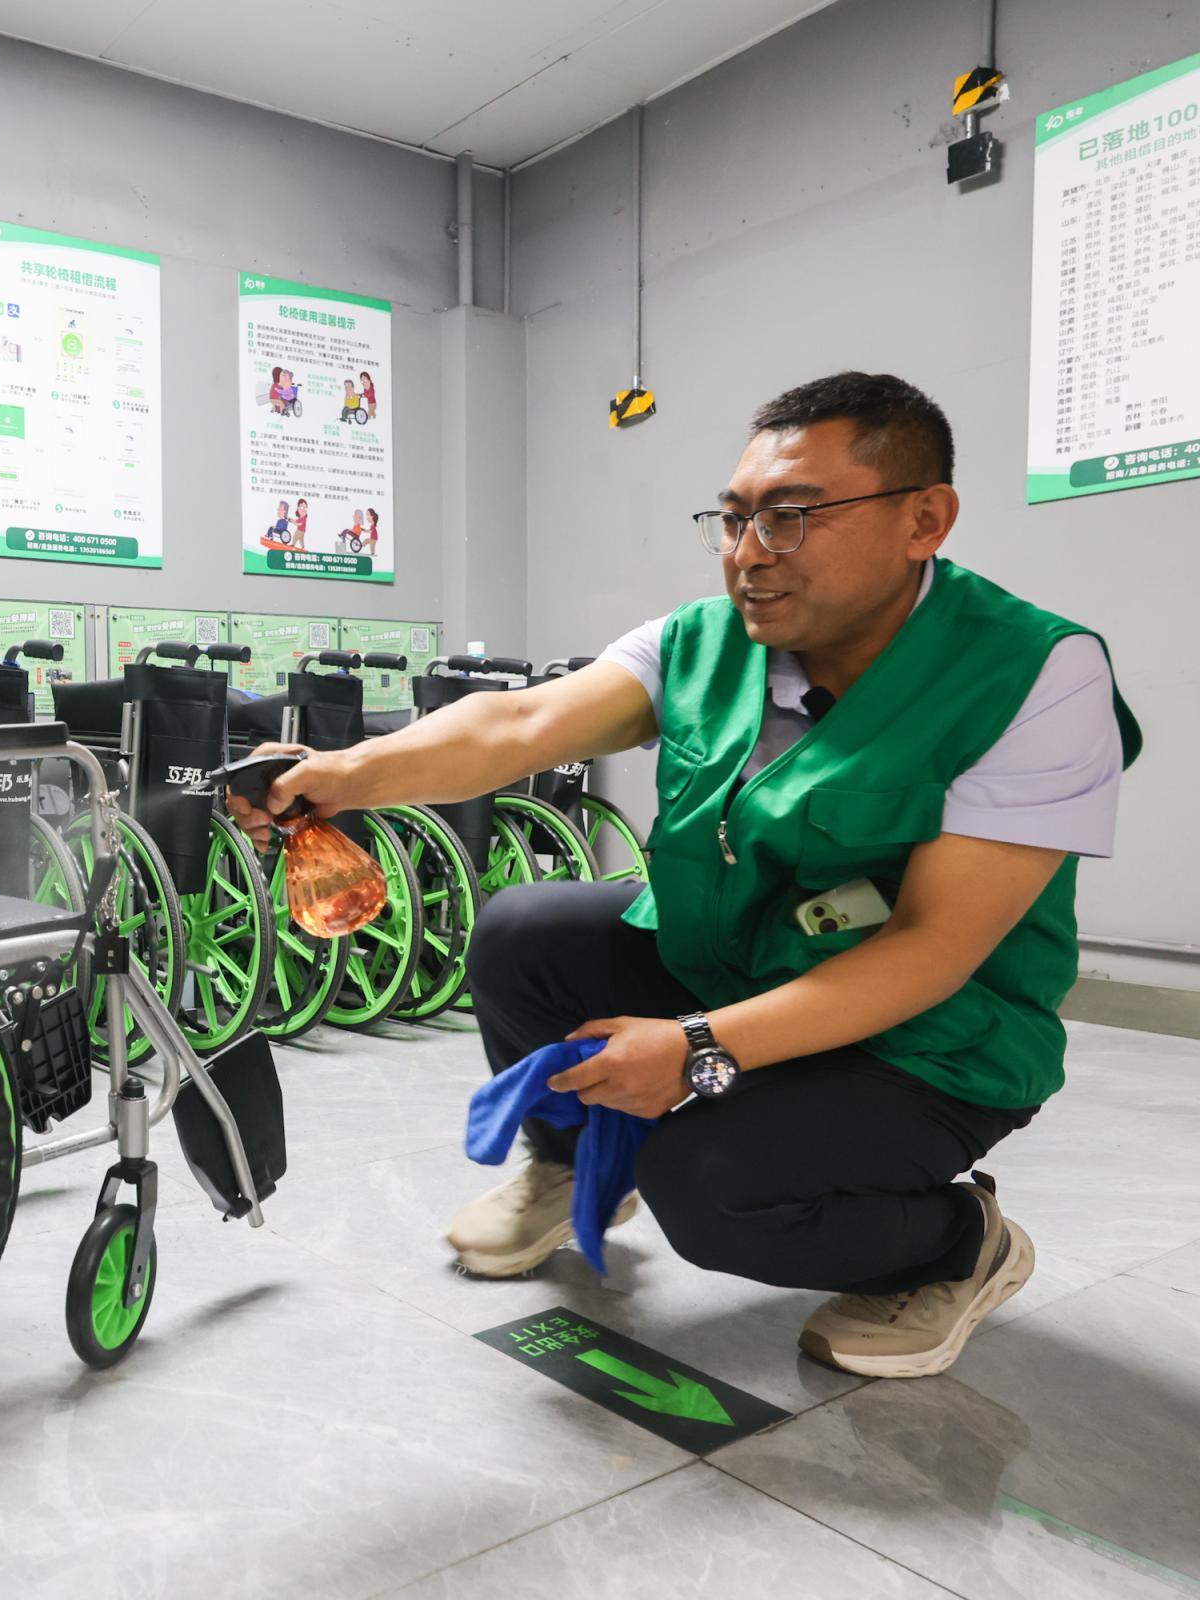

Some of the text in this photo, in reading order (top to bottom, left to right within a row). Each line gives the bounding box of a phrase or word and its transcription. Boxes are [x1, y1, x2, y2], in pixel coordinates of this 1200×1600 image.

[1079, 103, 1199, 160] 已落地100
[1096, 124, 1200, 171] 其他租借目的地
[20, 260, 117, 291] 共享轮椅租借流程
[509, 1317, 570, 1343] EXIT
